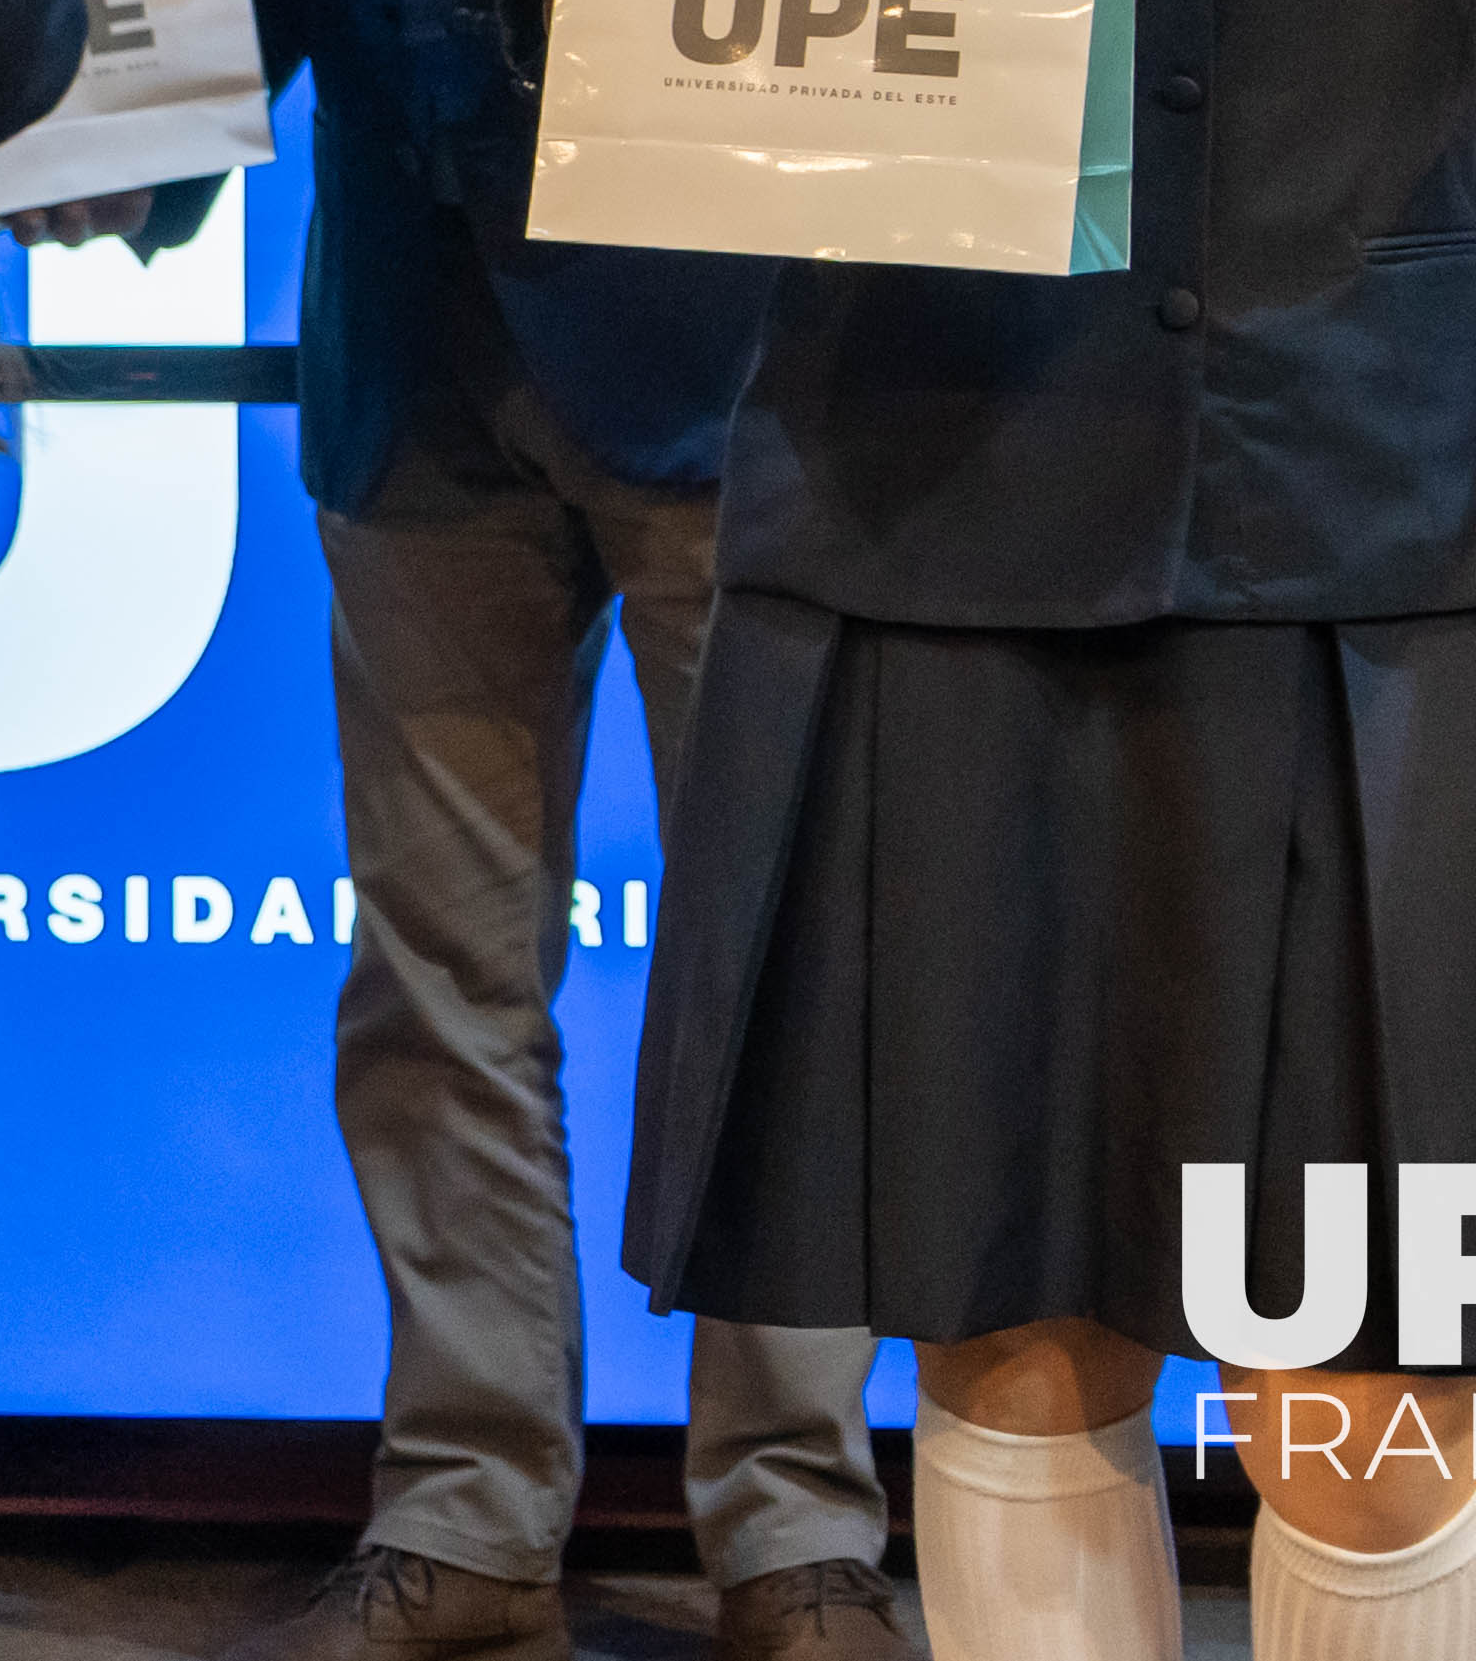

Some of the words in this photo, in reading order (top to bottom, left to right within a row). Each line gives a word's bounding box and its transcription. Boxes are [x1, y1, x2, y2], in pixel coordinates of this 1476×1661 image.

[663, 77, 781, 95] UNIVERSIDAD
[788, 84, 863, 100] PRIVADA
[872, 90, 906, 103] DEL
[914, 93, 958, 106] ESTE
